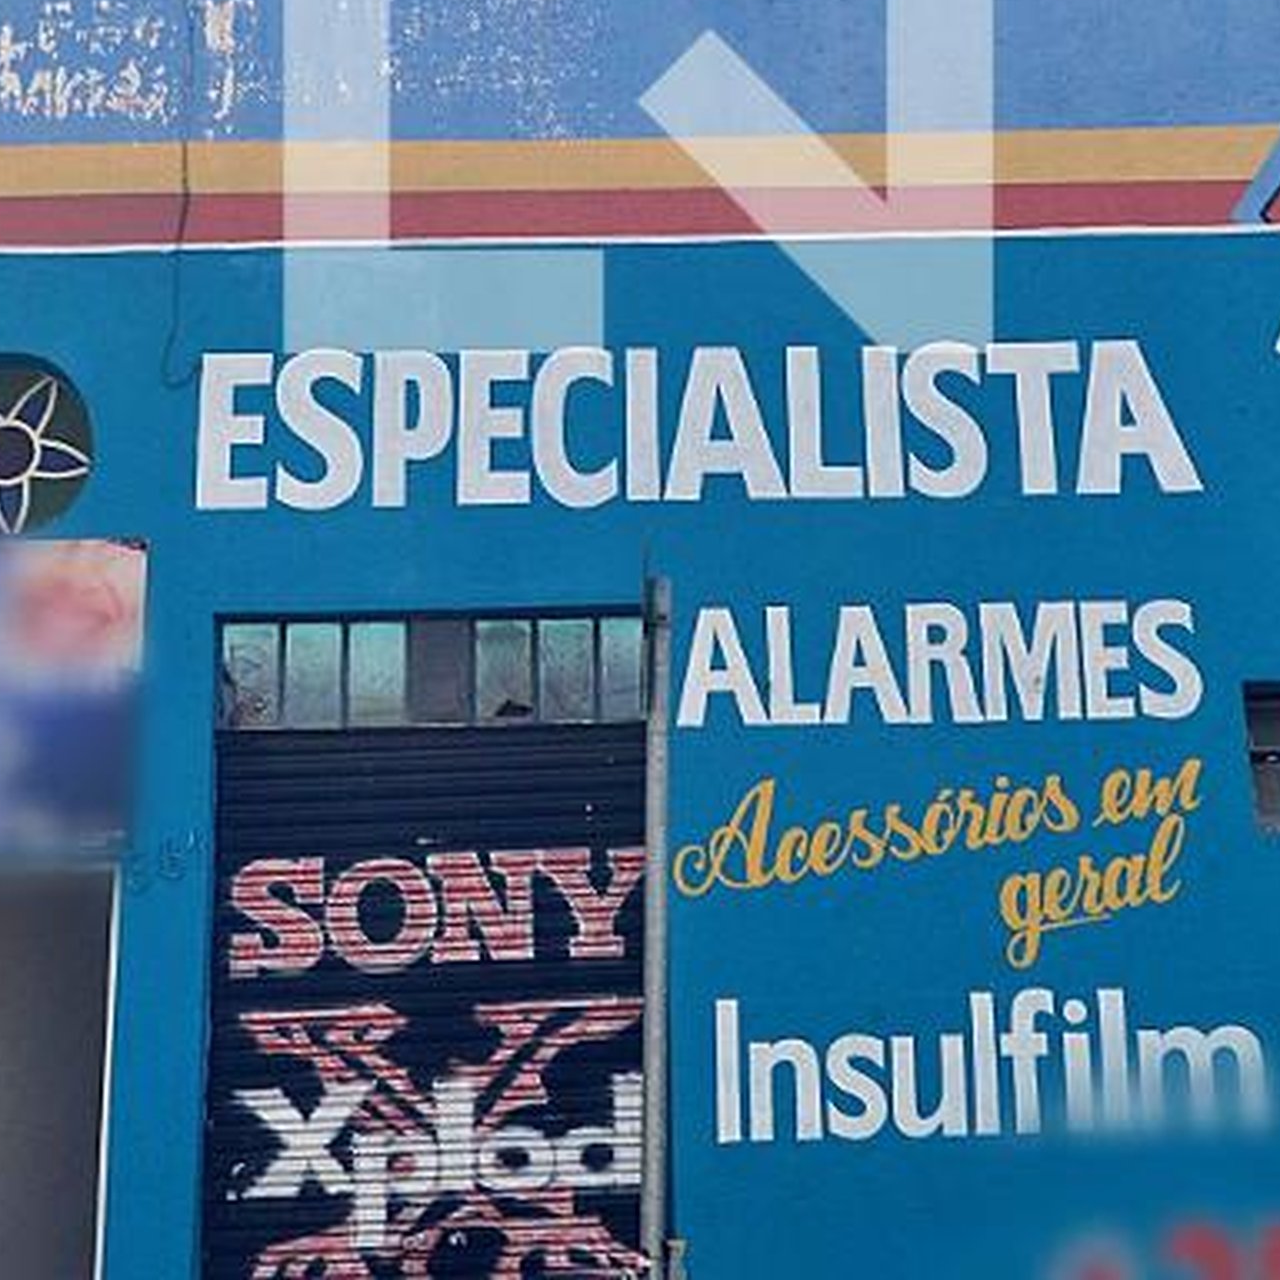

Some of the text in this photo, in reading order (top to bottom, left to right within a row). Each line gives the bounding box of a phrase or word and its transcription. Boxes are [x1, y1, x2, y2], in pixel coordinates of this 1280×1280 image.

[195, 341, 1204, 509] ESPECIALISTA
[677, 599, 1203, 727] ALARMES
[673, 758, 1202, 895] Acessórios em
[998, 814, 1184, 968] geral
[228, 846, 646, 978] SONY
[715, 988, 1275, 1144] Insulfilm
